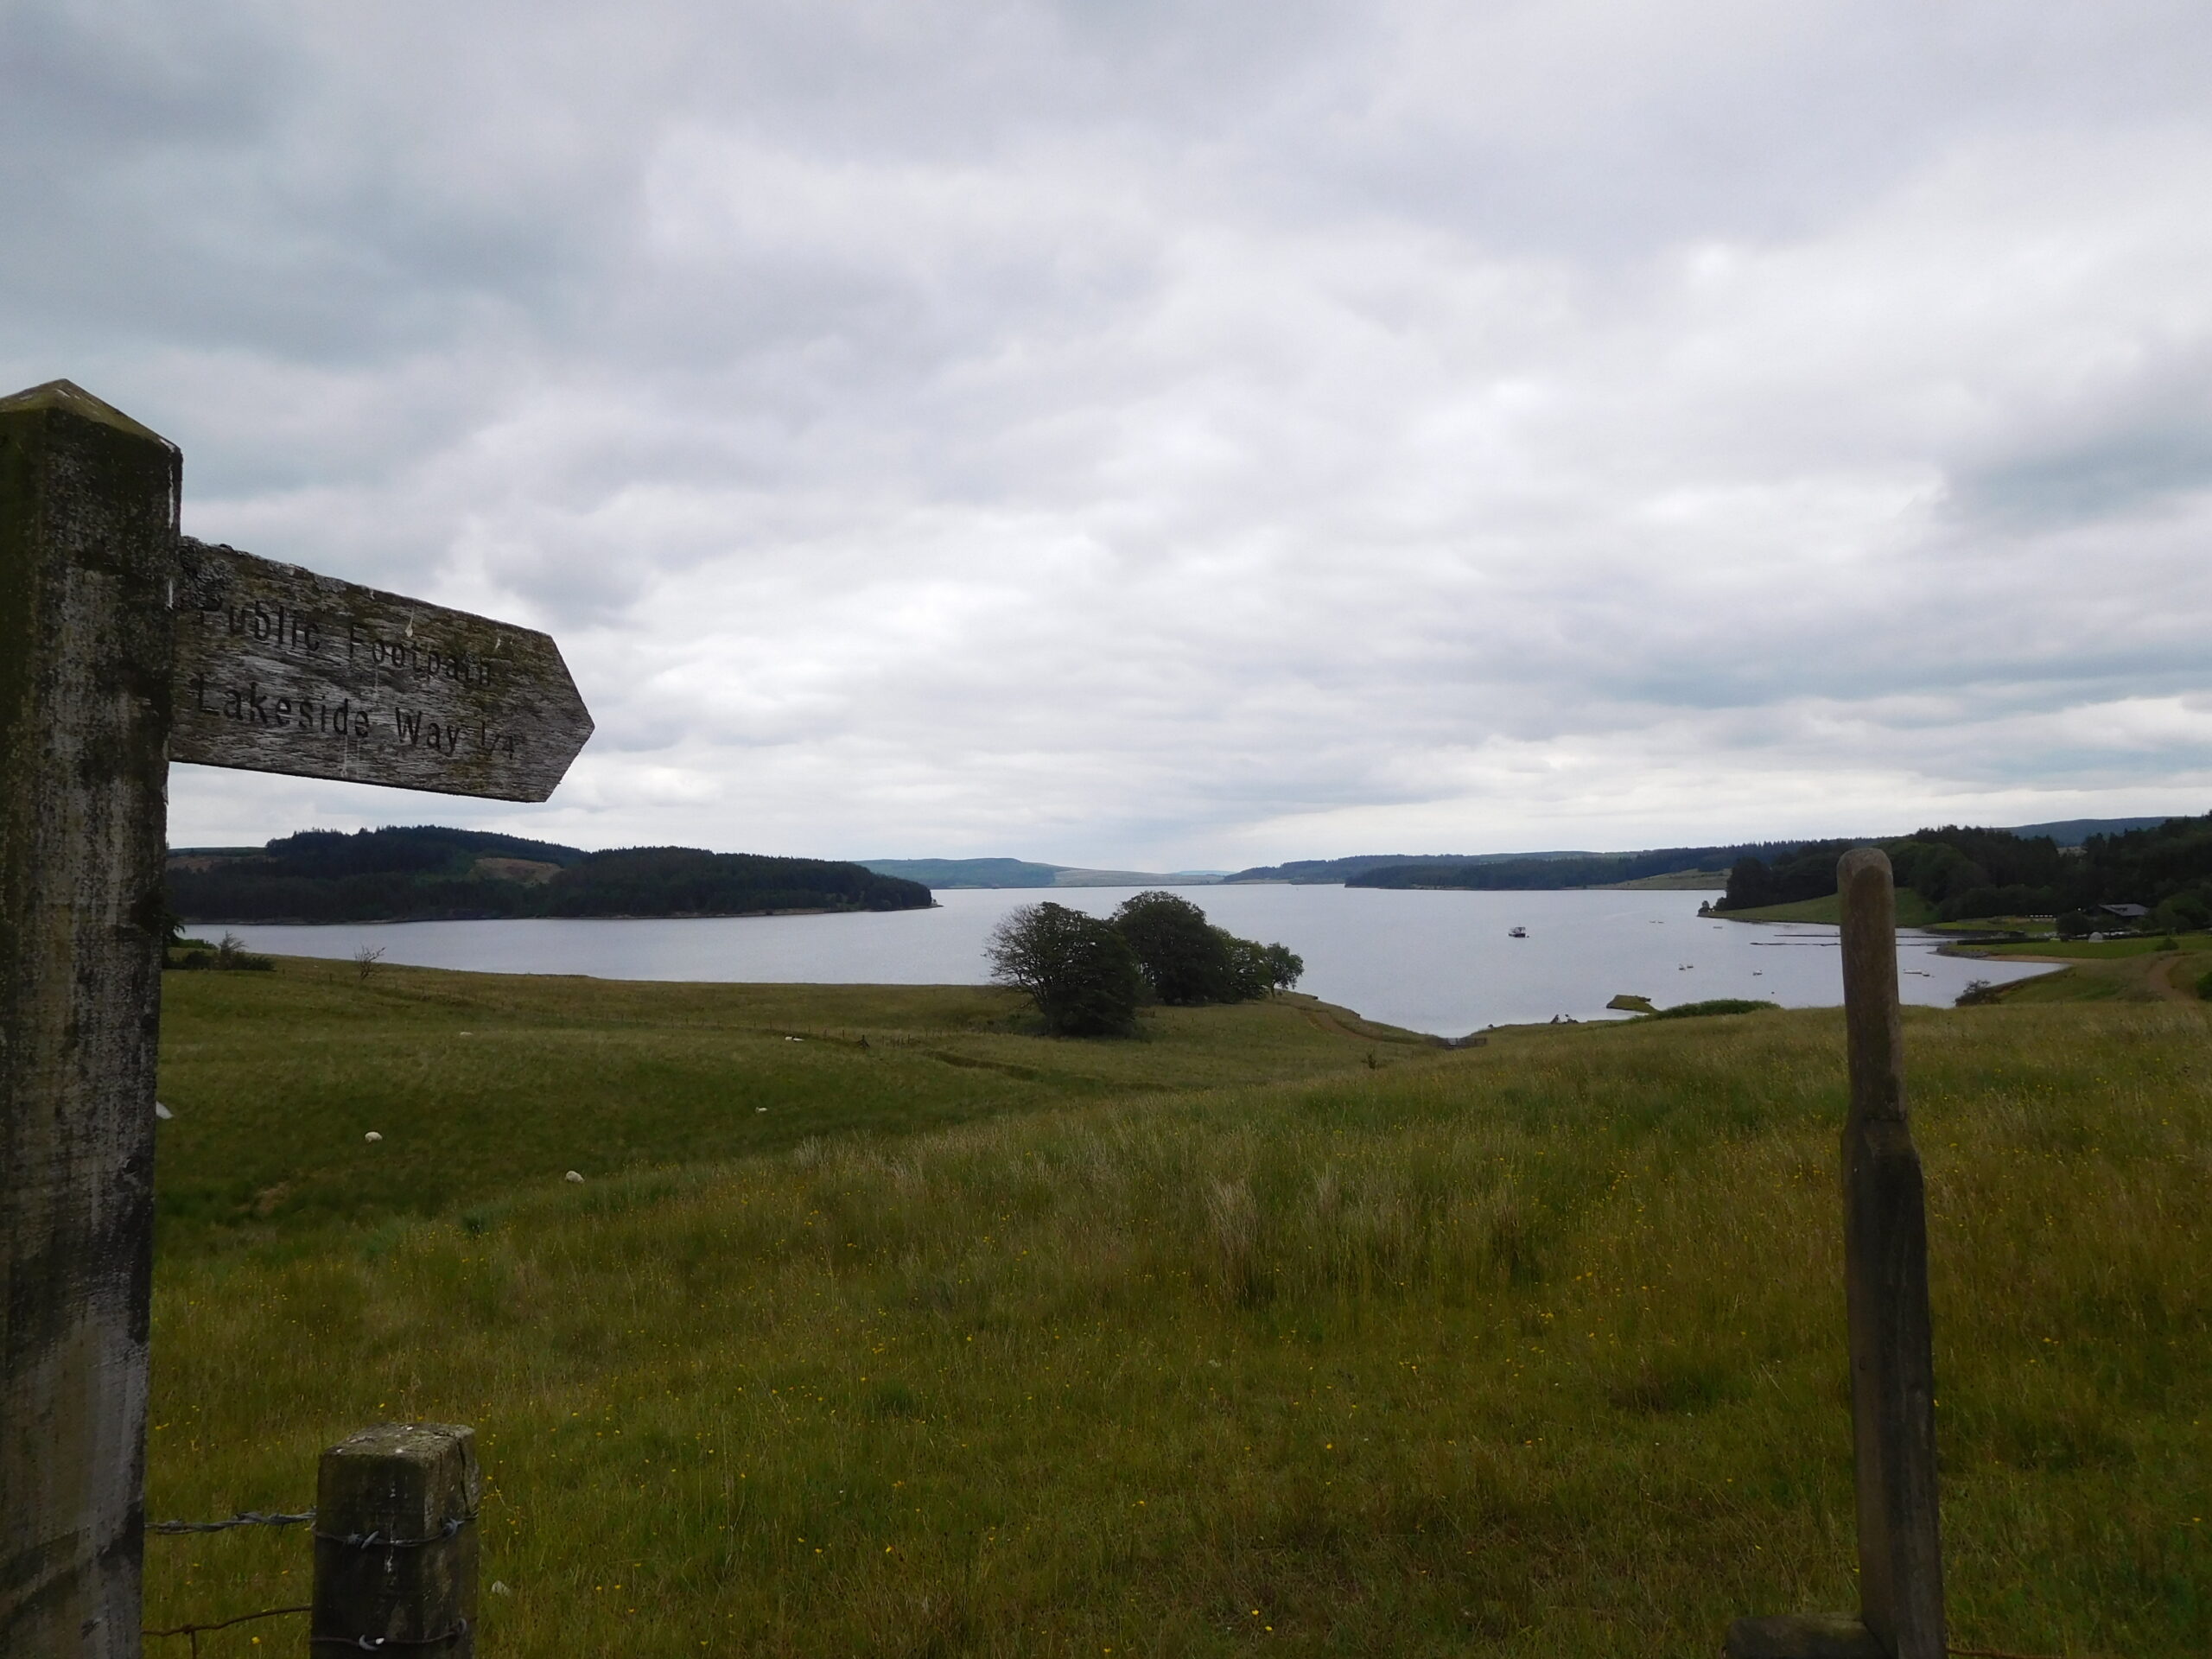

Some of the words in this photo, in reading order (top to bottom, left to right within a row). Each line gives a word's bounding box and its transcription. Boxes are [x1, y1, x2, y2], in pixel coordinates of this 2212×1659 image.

[199, 597, 321, 652] Public
[349, 621, 492, 686] Footpath
[198, 673, 370, 737] Lakeside
[396, 707, 461, 756] Way
